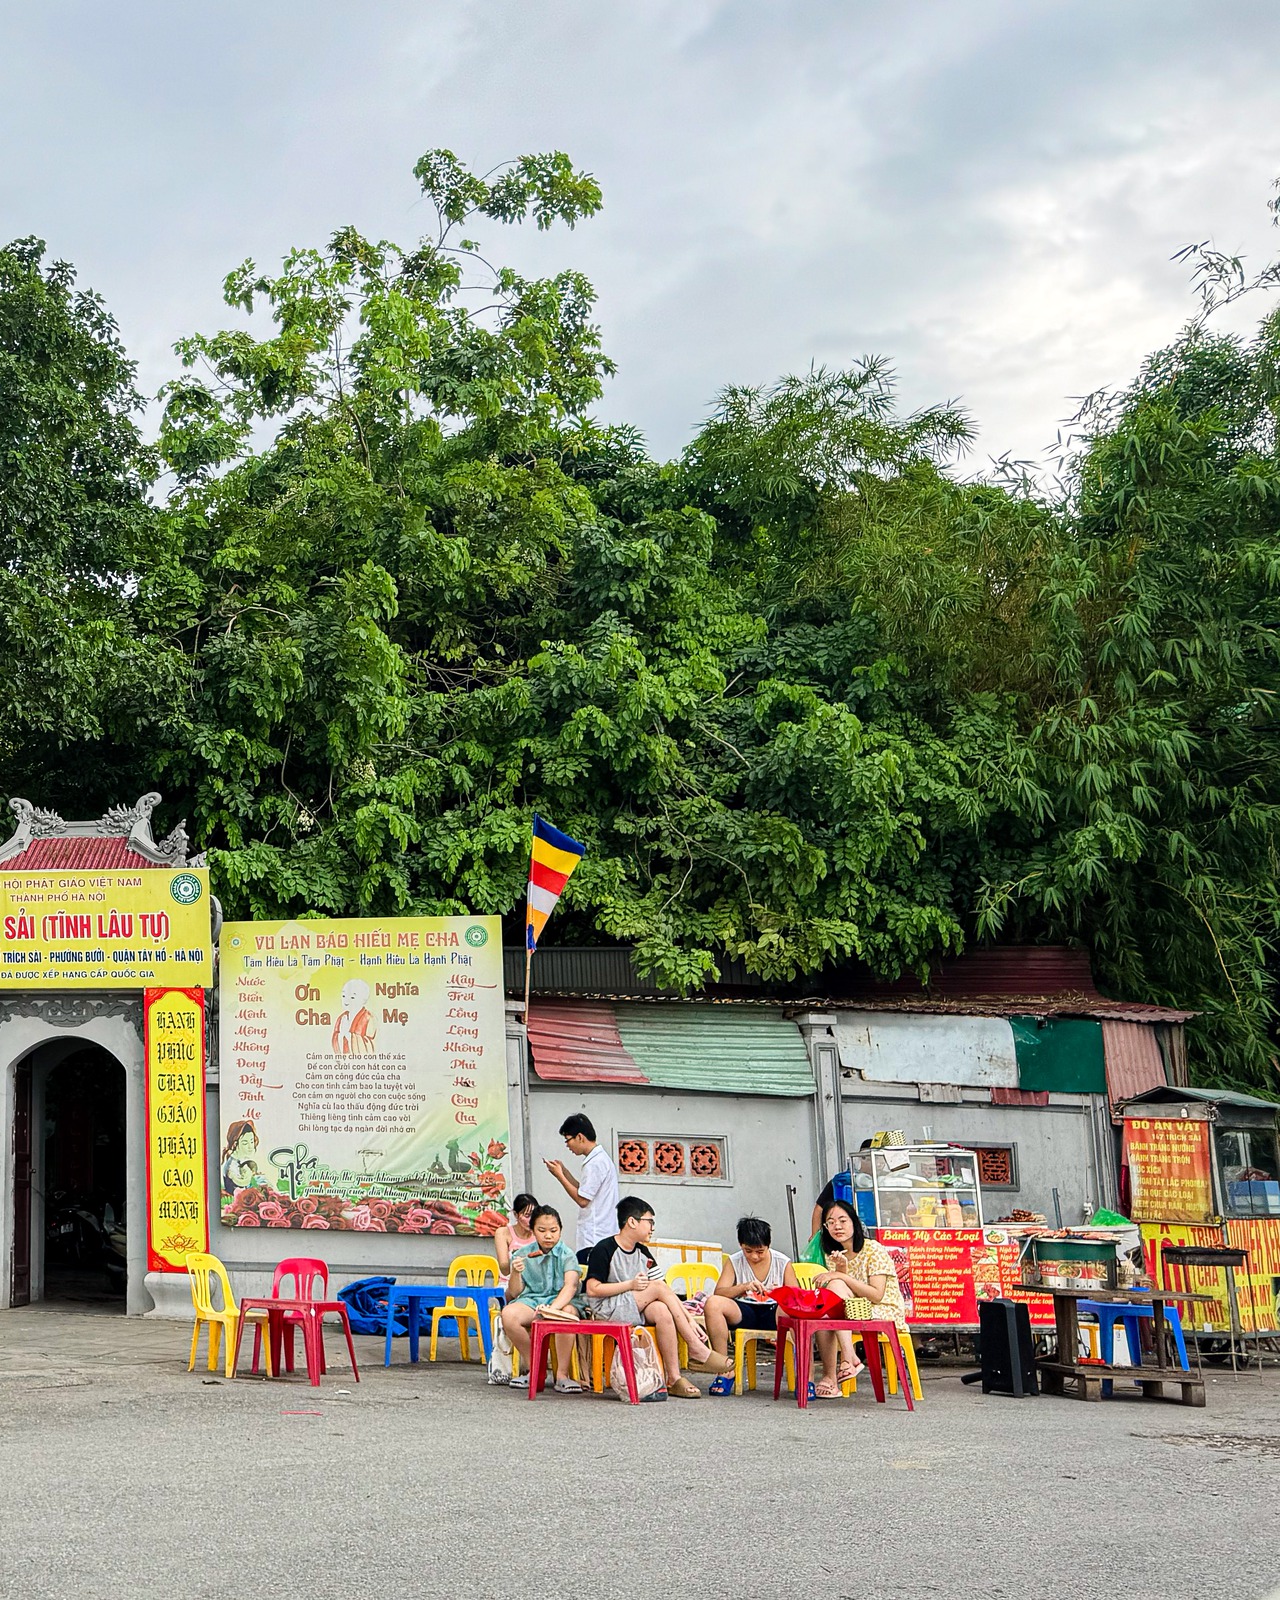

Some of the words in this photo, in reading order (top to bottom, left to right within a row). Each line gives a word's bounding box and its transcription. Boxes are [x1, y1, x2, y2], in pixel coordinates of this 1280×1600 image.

[4, 878, 22, 890] HỘI
[26, 877, 55, 890] PHẬT
[58, 877, 85, 888] GIÁO
[90, 876, 113, 888] VIỆT
[118, 878, 142, 886] NAM
[10, 893, 44, 902] THÀNH
[48, 891, 69, 902] PHỐ
[71, 892, 85, 901] HÀ
[89, 891, 106, 902] NỘI
[4, 908, 35, 940] SẢI
[42, 911, 91, 942] (TĨNH
[98, 909, 133, 939] LÂU
[139, 911, 170, 943] TỰ)
[255, 936, 275, 950] VU
[280, 934, 310, 949] LAN
[316, 931, 348, 949] BÁO
[353, 928, 391, 948] HIẾU
[397, 932, 419, 950] MẸ
[426, 932, 460, 947] CHA
[3, 949, 26, 963] TRÍCH
[29, 949, 42, 962] SÀI
[50, 949, 83, 962] PHƯỜNG
[85, 948, 105, 962] BƯỞI
[113, 948, 135, 964] QUẬN
[138, 948, 153, 961] TÂY
[175, 947, 187, 961] HÀ
[189, 947, 203, 964] NỘI
[288, 955, 298, 966] Là
[409, 953, 419, 964] Là
[16, 970, 40, 979] ĐƯỢC
[43, 968, 59, 978] XẾP
[63, 970, 87, 980] HẠNG
[90, 968, 108, 978] CẤP
[111, 968, 137, 978] QUỐC
[235, 976, 266, 987] Nước
[295, 984, 320, 1001] Ơn
[375, 982, 419, 998] Nghĩa
[235, 1009, 267, 1020] Mênh
[295, 1008, 331, 1025] Cha
[383, 1009, 408, 1026] Mẹ
[235, 1025, 268, 1038] Mông
[157, 1039, 195, 1064] PHÚC
[232, 1041, 270, 1055] Không
[442, 1042, 484, 1056] Không
[236, 1058, 266, 1071] Đong
[157, 1074, 195, 1096] THAY
[451, 1093, 479, 1108] Công
[157, 1101, 197, 1123] GIÁO
[455, 1111, 477, 1125] Cha
[299, 1124, 311, 1132] Ghi
[158, 1133, 196, 1159] PHÁP
[163, 1169, 193, 1187] CAO
[159, 1201, 198, 1224] MINH
[883, 1230, 911, 1241] Bánh
[933, 1231, 952, 1240] Các
[955, 1231, 980, 1242] Loại
